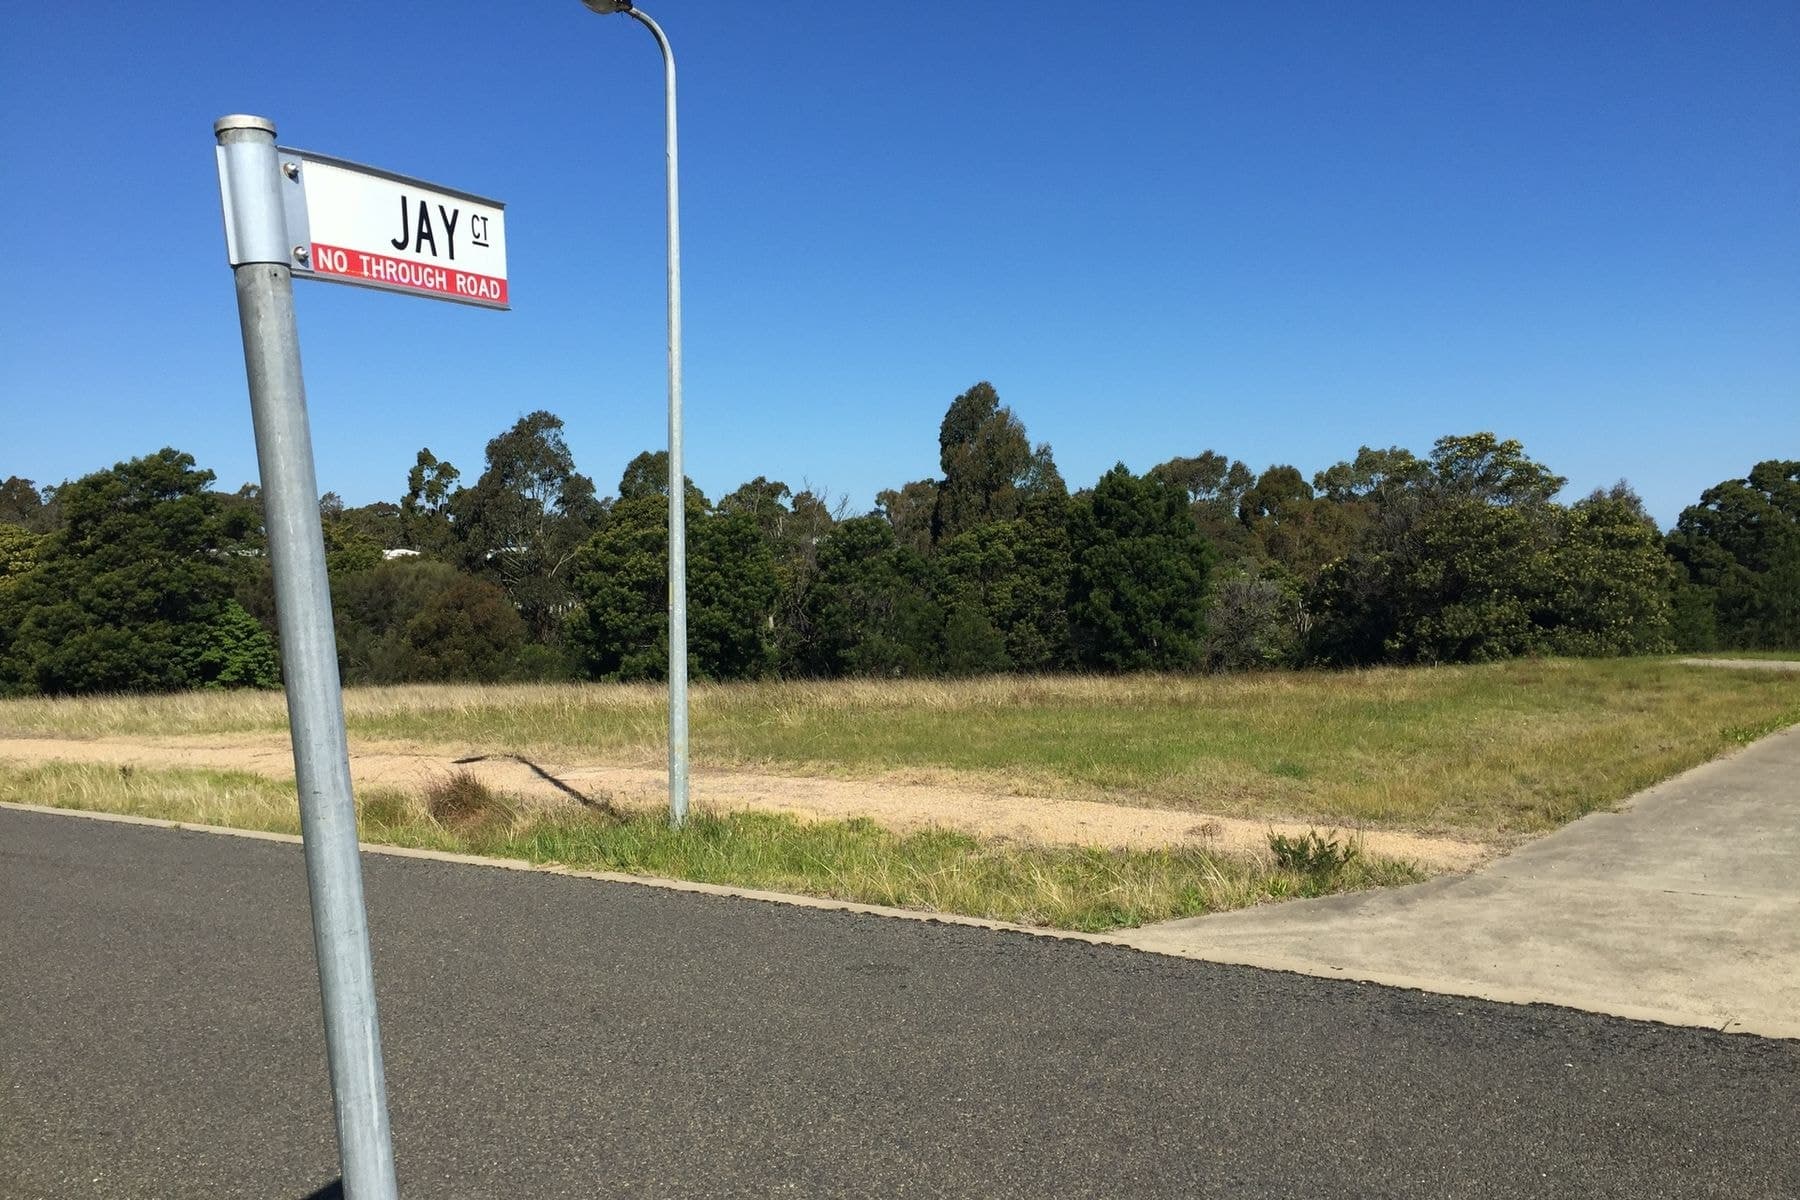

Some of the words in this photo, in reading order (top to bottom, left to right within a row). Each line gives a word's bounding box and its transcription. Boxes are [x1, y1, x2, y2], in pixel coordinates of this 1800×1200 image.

[391, 195, 459, 260] JAY
[471, 214, 489, 241] CT
[317, 248, 348, 272] NO
[359, 255, 447, 290] THROUGH
[456, 274, 500, 299] ROAD
